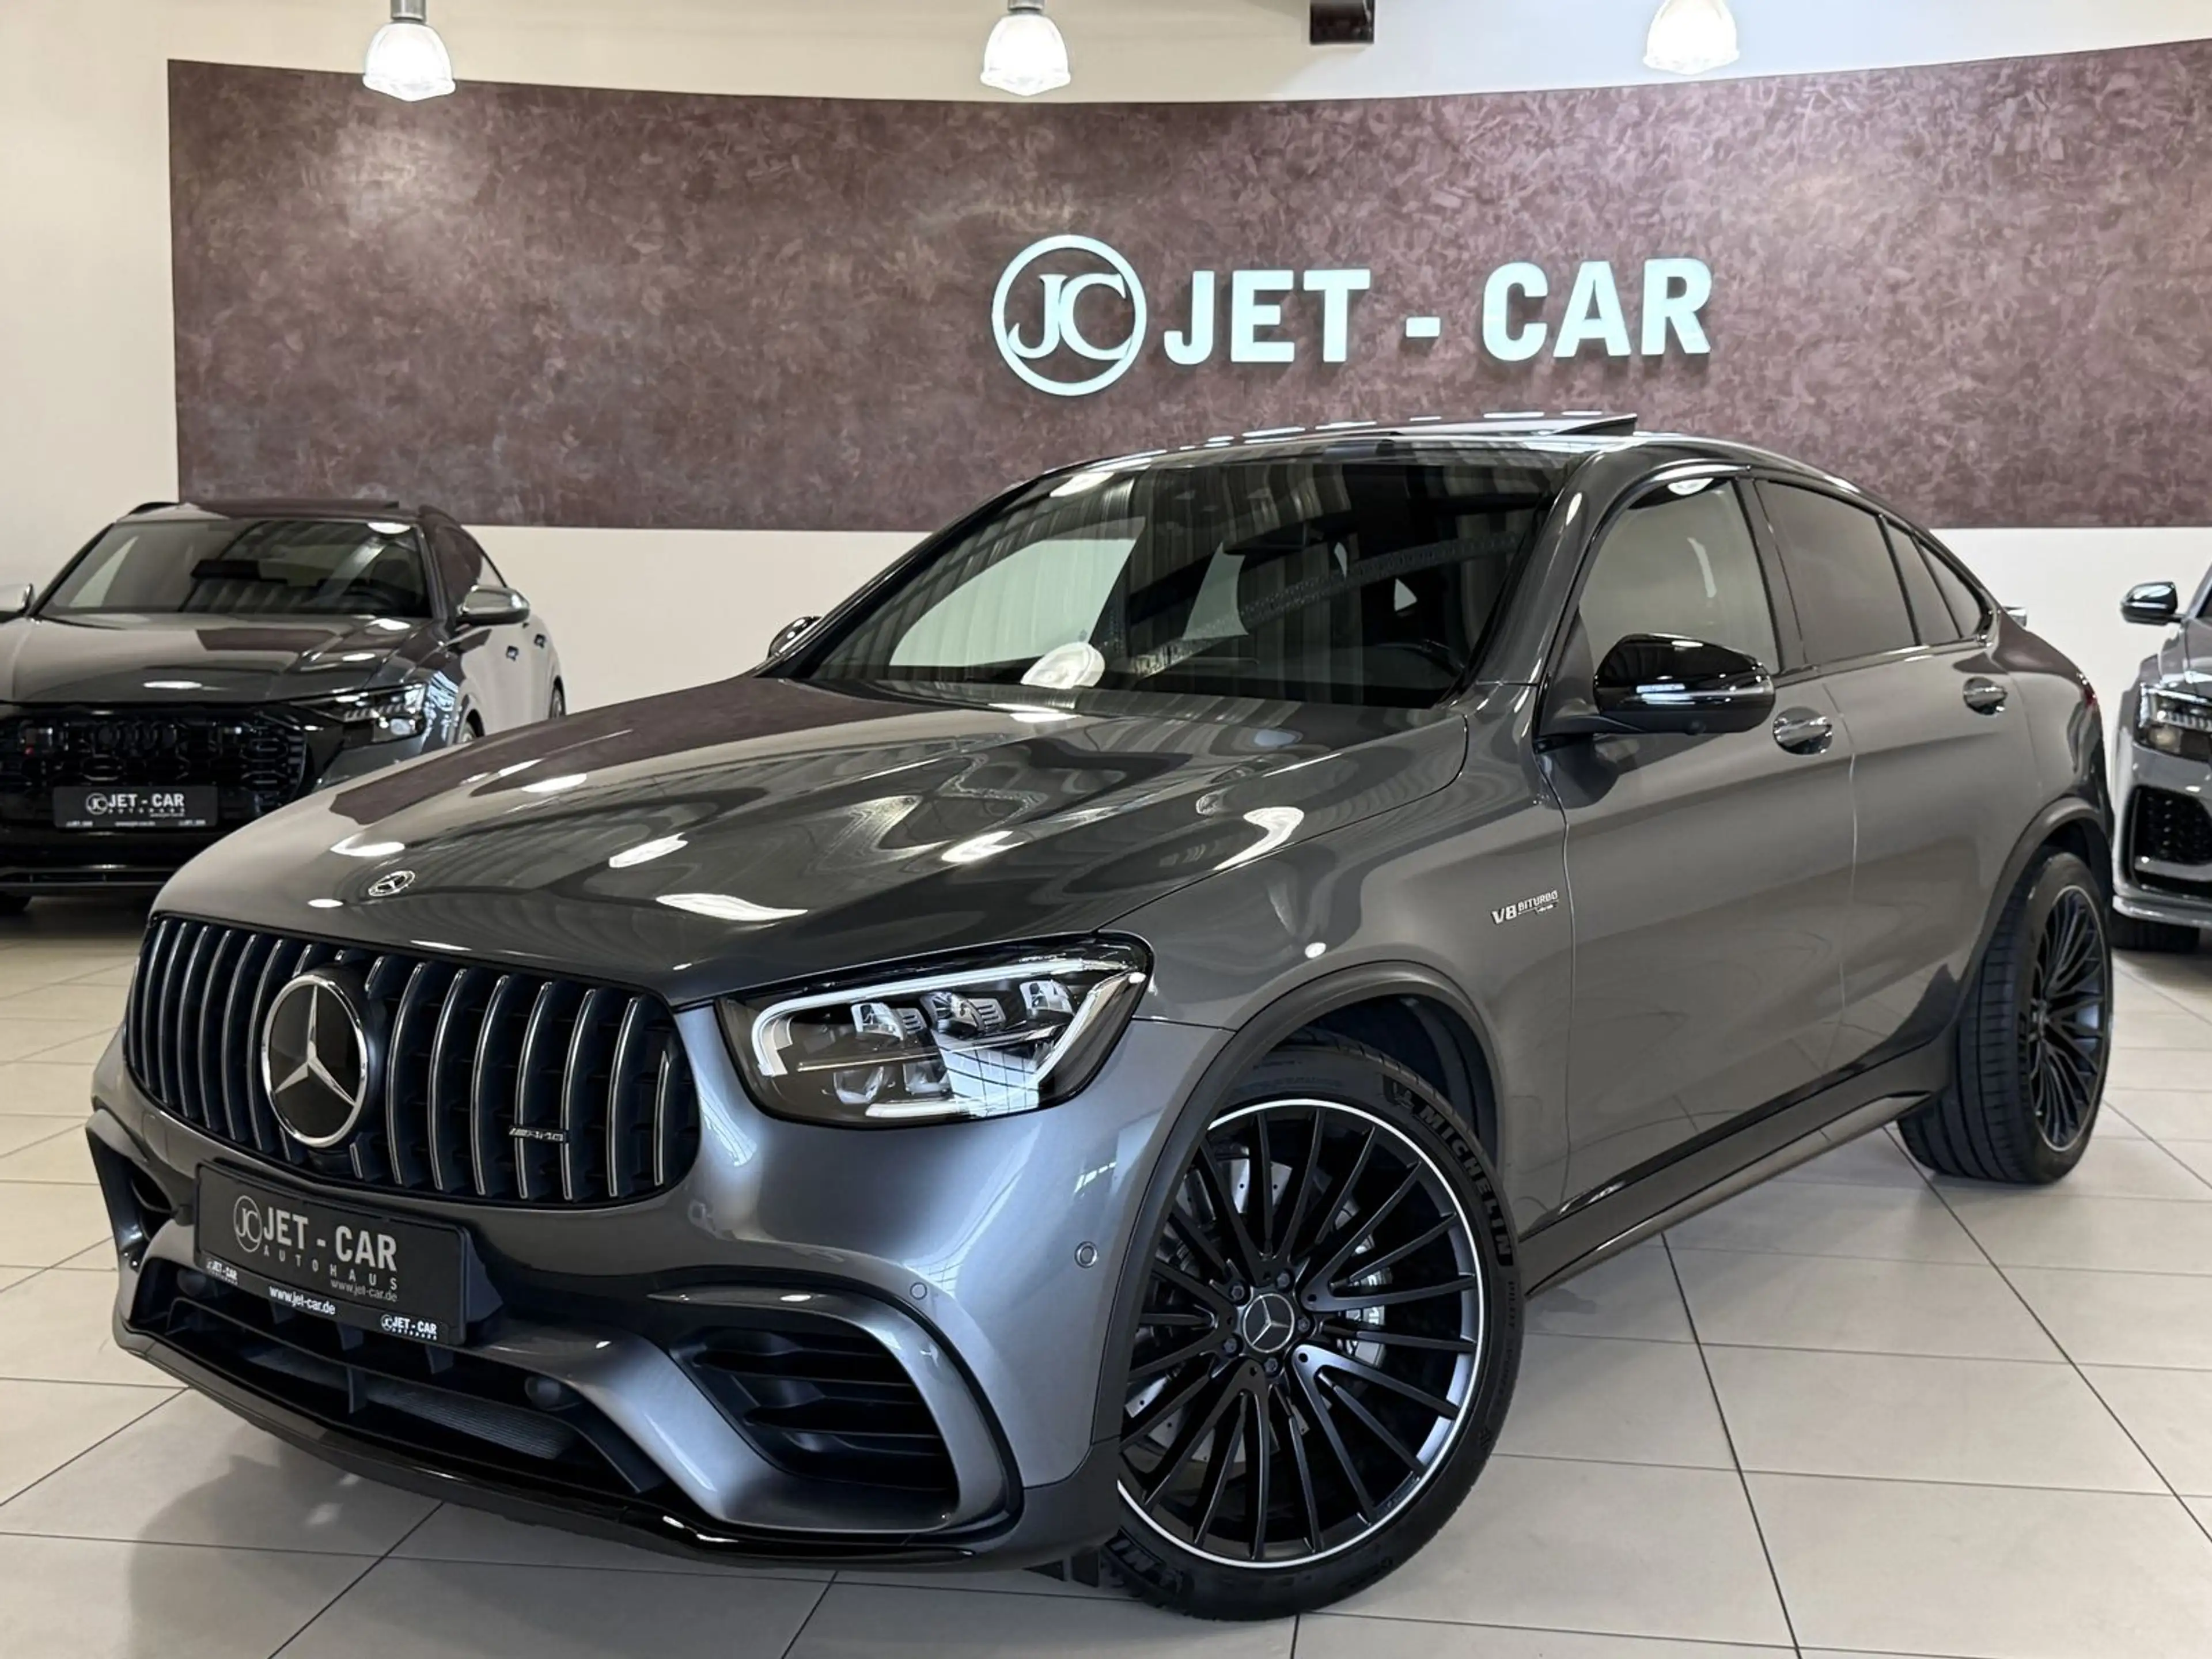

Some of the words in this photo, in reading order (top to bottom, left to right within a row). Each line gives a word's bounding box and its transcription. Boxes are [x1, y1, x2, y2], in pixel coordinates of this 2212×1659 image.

[1164, 268, 1370, 365] JET
[1482, 258, 1712, 361] CAR
[108, 794, 138, 808] JET
[151, 793, 184, 807] CAR
[1491, 904, 1517, 924] V8
[1518, 890, 1558, 911] BITURBO
[1418, 1105, 1512, 1257] MICHELIN
[264, 1207, 309, 1250] JET
[335, 1225, 397, 1272] CAR
[263, 1245, 397, 1290] AUTOHAUS
[269, 1285, 336, 1316] www.jet-car.de
[330, 1279, 398, 1303] www.jet-car.de
[392, 1316, 410, 1330] JET
[418, 1321, 437, 1335] CAR
